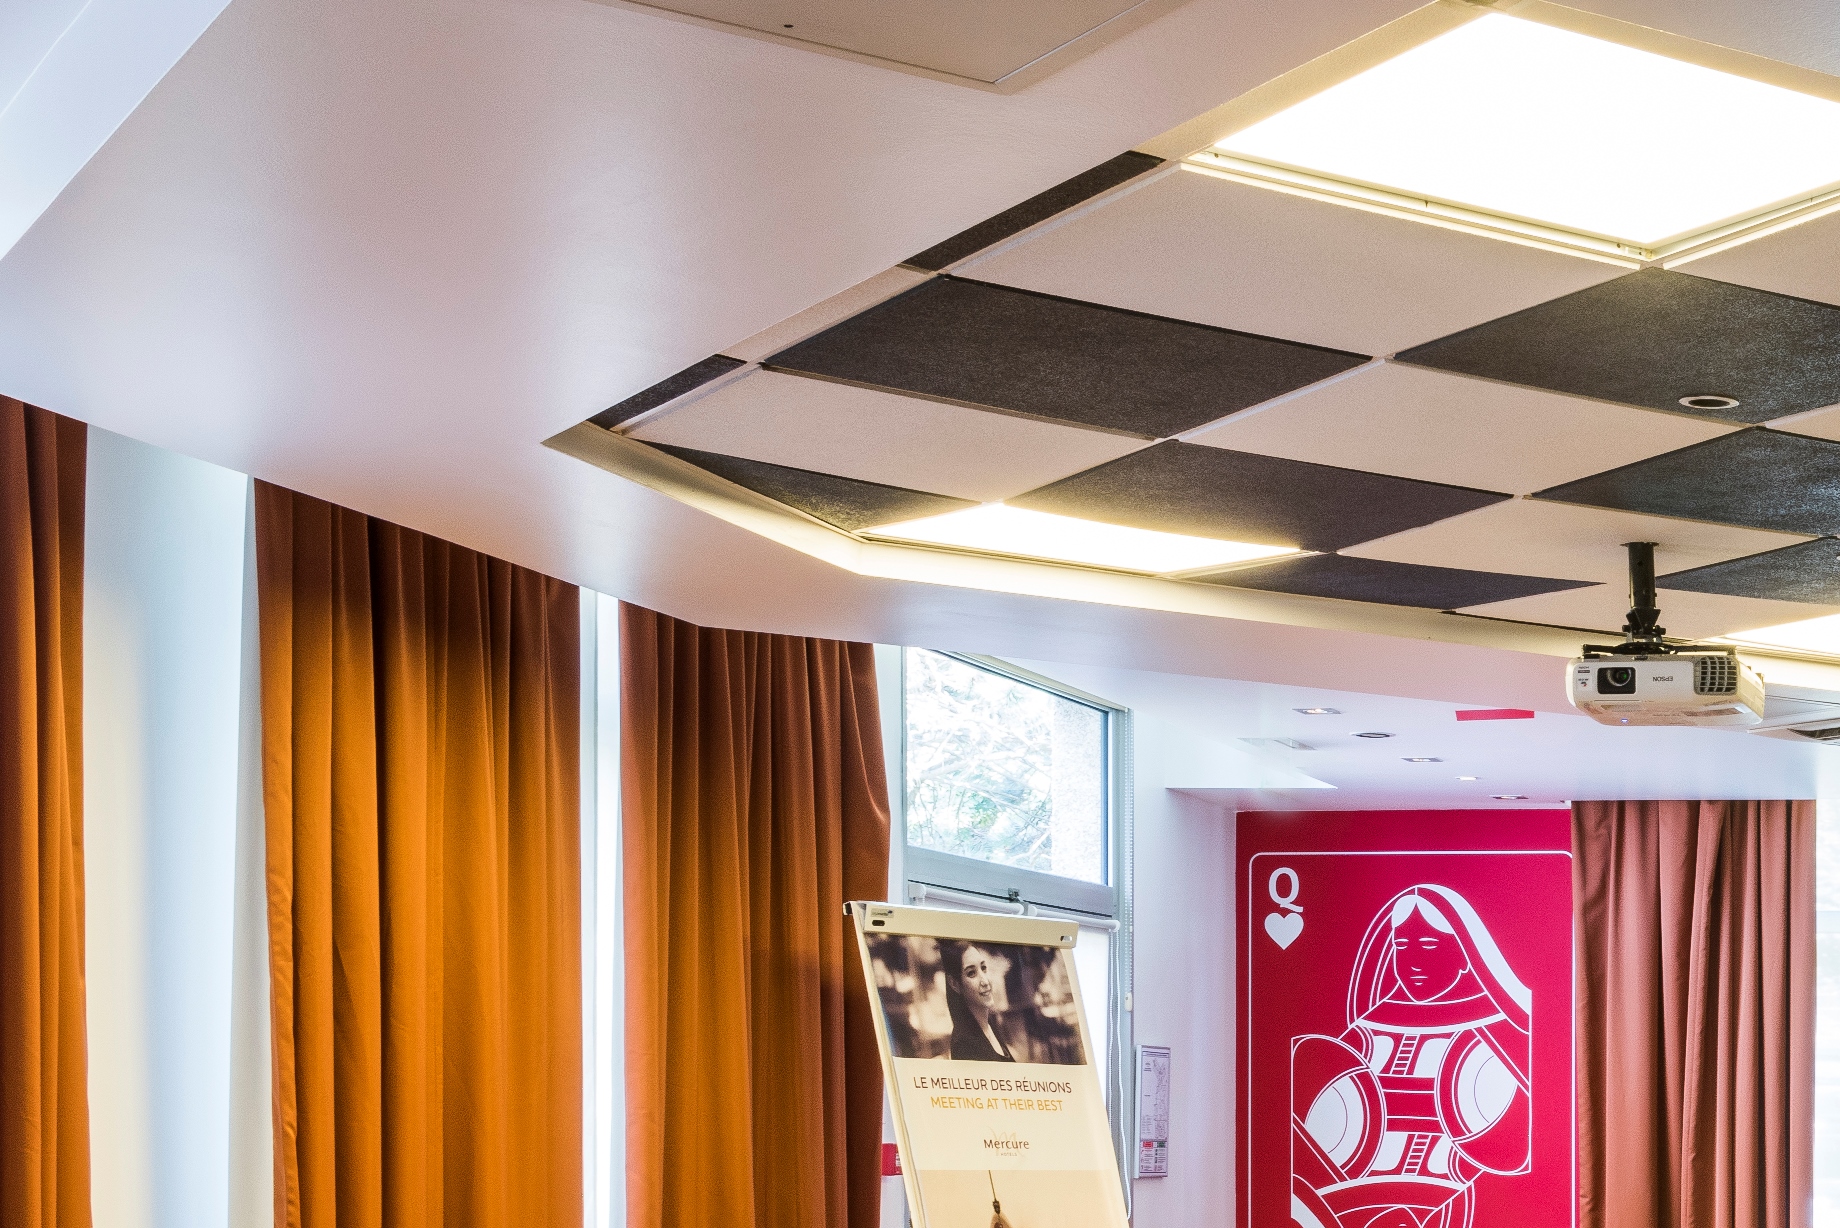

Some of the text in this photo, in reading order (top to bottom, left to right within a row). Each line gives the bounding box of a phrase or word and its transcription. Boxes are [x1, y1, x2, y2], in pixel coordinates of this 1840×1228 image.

[1268, 866, 1303, 912] Q
[914, 1076, 1072, 1093] LE MEILLEUR DES RÉUNIONS
[931, 1096, 1063, 1111] MEETING AT THEIR BEST
[984, 1139, 1030, 1150] Mercure
